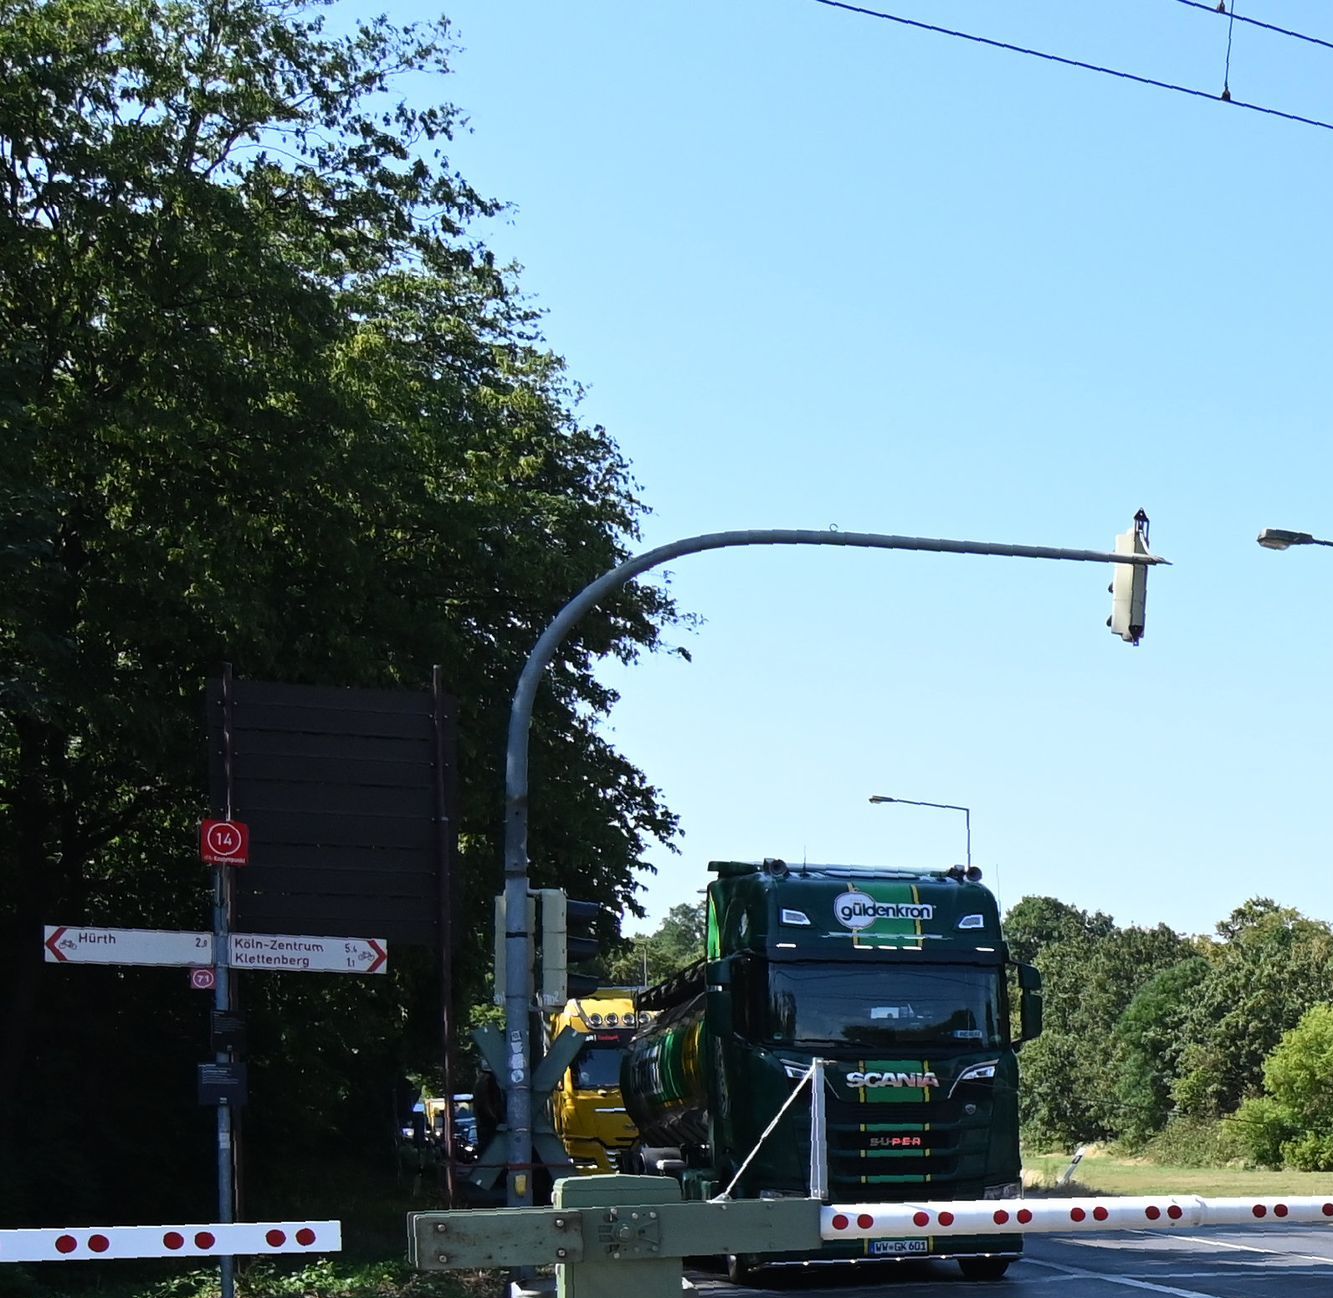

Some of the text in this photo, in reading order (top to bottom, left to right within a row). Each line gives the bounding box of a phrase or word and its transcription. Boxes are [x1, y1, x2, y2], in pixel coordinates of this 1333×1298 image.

[216, 832, 232, 846] 14
[841, 902, 931, 921] güldenkron
[78, 932, 116, 945] Hürth
[234, 938, 324, 953] Köln-Zentrum
[235, 953, 310, 968] Klettenberg
[197, 975, 210, 983] 71
[846, 1071, 940, 1088] SCANIA
[869, 1137, 921, 1146] SUPER
[908, 1241, 926, 1251] 601
